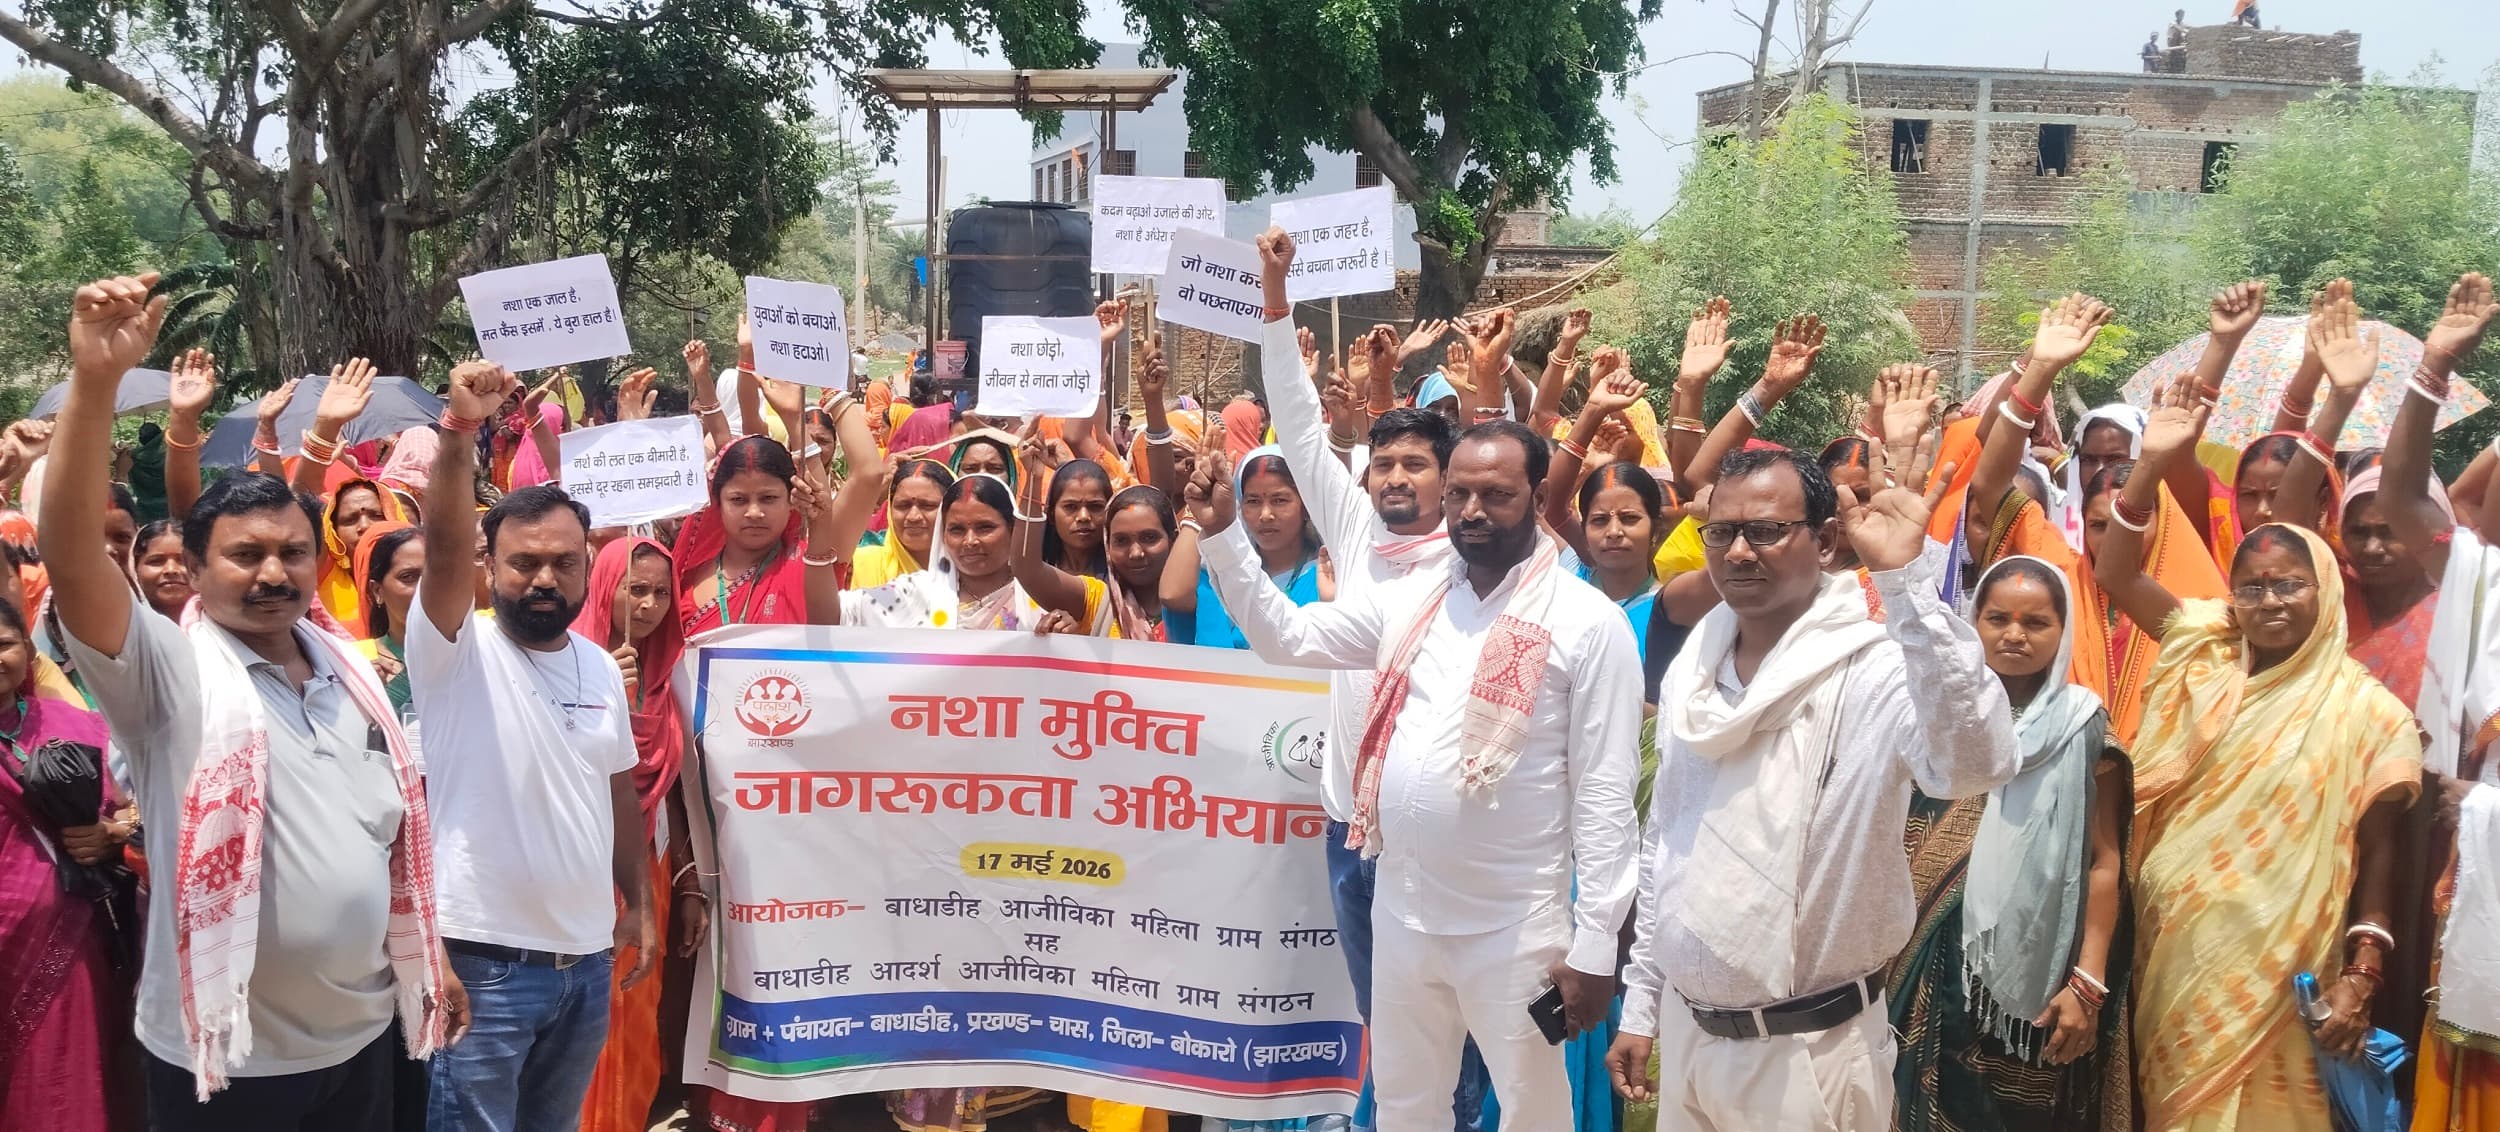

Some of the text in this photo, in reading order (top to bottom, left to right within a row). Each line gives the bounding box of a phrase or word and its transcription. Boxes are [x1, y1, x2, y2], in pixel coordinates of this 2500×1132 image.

[1101, 205, 1123, 217] कदम
[1153, 203, 1180, 219] उजाले
[1181, 204, 1194, 219] की
[1115, 229, 1134, 241] नशा
[1135, 226, 1143, 242] है
[1312, 226, 1331, 242] एक
[1333, 222, 1359, 240] जहर
[1361, 215, 1373, 238] है,
[1181, 254, 1202, 272] जो
[1204, 262, 1237, 282] नशा
[1286, 258, 1304, 278] ससे
[1307, 258, 1334, 274] बचना
[1370, 246, 1380, 268] है
[502, 299, 523, 312] नशा
[525, 297, 542, 310] एक
[545, 291, 567, 306] जाल
[1178, 283, 1264, 319] वो पछताएगा
[480, 328, 498, 341] मत
[519, 317, 545, 337] इसमें
[554, 315, 563, 328] ये
[564, 315, 580, 335] बुरा
[582, 311, 603, 327] हाल
[753, 304, 841, 333] युवाओं को बचाओ,
[769, 340, 791, 357] नशा
[1010, 336, 1065, 362] नशा छोड़ो,
[985, 368, 1091, 393] जीवन से नाता जोड़ो
[573, 454, 591, 470] नशे
[593, 451, 606, 468] की
[608, 454, 625, 467] लत
[628, 452, 645, 465] एक
[647, 445, 677, 464] बीमारी
[569, 479, 593, 497] इससे
[596, 481, 609, 499] दूर
[611, 479, 635, 493] रहना
[637, 471, 682, 490] समझदारी
[888, 689, 1206, 761] नशा मुक्ति
[734, 771, 1328, 845] जागरूकता अभियान
[977, 850, 1112, 880] 17 मई 2026
[728, 890, 1338, 950] आयोजक- बाधाडीह आजीविका महिला ग्राम संगठ
[1024, 932, 1061, 955] सह
[753, 953, 1315, 1014] बाधाडीह आदर्श आजीविका महिला ग्राम संगठन
[726, 1014, 757, 1041] ग्राम
[762, 1024, 775, 1043] +
[870, 1004, 959, 1033] बाधाडीह,
[1049, 1016, 1095, 1042] चास,
[1170, 1030, 1238, 1063] बोकारो
[1243, 1034, 1348, 1071] (झारखण्ड)
